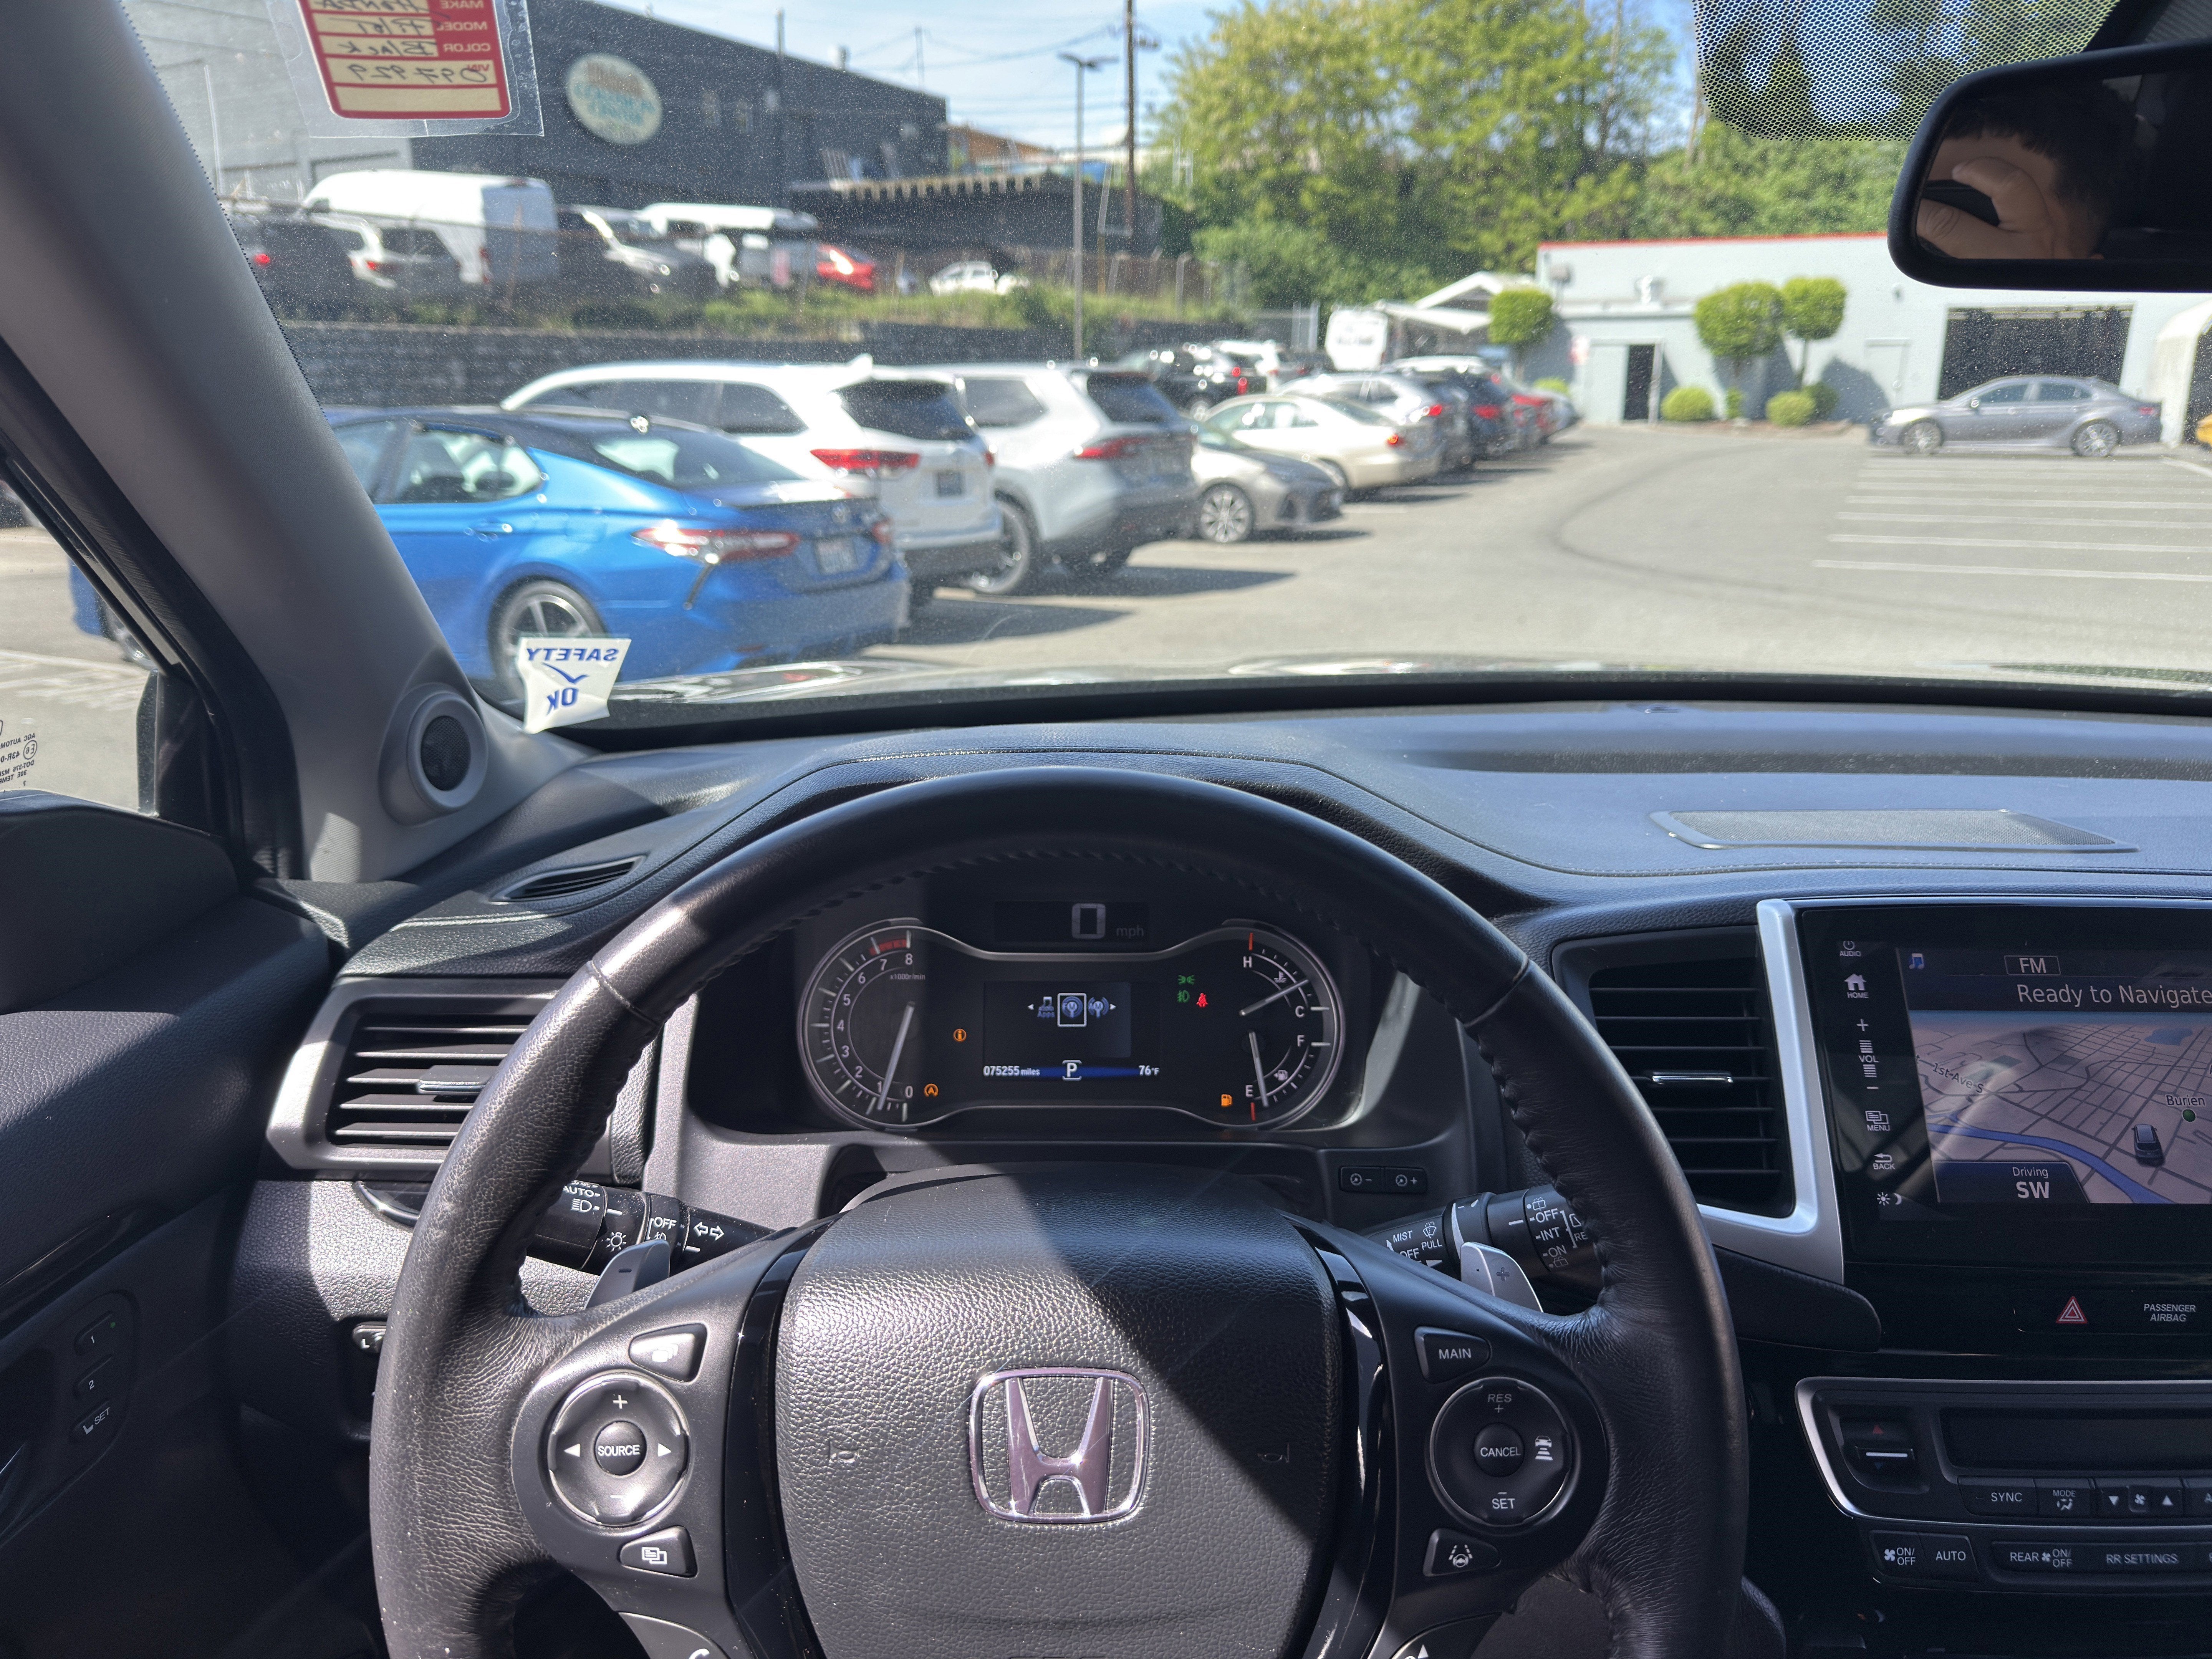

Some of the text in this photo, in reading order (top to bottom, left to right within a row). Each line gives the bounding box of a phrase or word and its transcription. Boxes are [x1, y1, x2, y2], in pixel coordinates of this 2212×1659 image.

[1072, 903, 1144, 939] 0 mph
[880, 959, 887, 971] 7
[905, 953, 913, 965] 8
[1243, 956, 1252, 968] H
[2019, 957, 2046, 974] FM
[858, 972, 866, 984] 6
[843, 994, 851, 1006] 5
[2017, 984, 2212, 1008] Ready to Navigate
[1295, 1006, 1305, 1018] C
[837, 1019, 844, 1031] 4
[1297, 1035, 1305, 1047] F
[842, 1045, 849, 1058] 3
[1859, 1055, 1879, 1063] VOL
[856, 1066, 863, 1078] 2
[983, 1066, 1040, 1077] 075255 miles
[1066, 1062, 1078, 1078] P
[1933, 1063, 1984, 1093] 1st Ave S
[905, 1085, 913, 1098] 0
[1245, 1085, 1253, 1098] E
[2166, 1095, 2205, 1106] Burien
[2013, 1167, 2048, 1179] Driving
[563, 1185, 594, 1198] AUTO
[2016, 1181, 2050, 1199] SW
[1535, 1208, 1558, 1223] OFF
[653, 1217, 677, 1230] OFF
[1393, 1230, 1413, 1243] MIST
[1540, 1227, 1560, 1241] INT
[1421, 1239, 1443, 1250] PULL
[1548, 1245, 1567, 1257] ON
[2144, 1303, 2196, 1312] PASSENGER
[2150, 1313, 2187, 1322] AIRBAG
[91, 1335, 95, 1343] 1
[1438, 1348, 1472, 1360] MAIN
[89, 1380, 95, 1390] 2
[1487, 1393, 1512, 1403] RES
[94, 1407, 110, 1425] SET
[597, 1444, 641, 1457] SOURCE
[1480, 1446, 1522, 1458] CANCEL
[1990, 1492, 2023, 1502] SYNC
[2053, 1489, 2076, 1497] MODE
[1492, 1498, 1516, 1510] SET
[1896, 1547, 1915, 1556] ON/
[1936, 1550, 1966, 1561] AUTO
[2010, 1548, 2071, 1562] REAR ON/
[1897, 1556, 1916, 1566] OFF
[2052, 1558, 2073, 1568] OFF
[2106, 1553, 2180, 1565] RR SETTINGS
